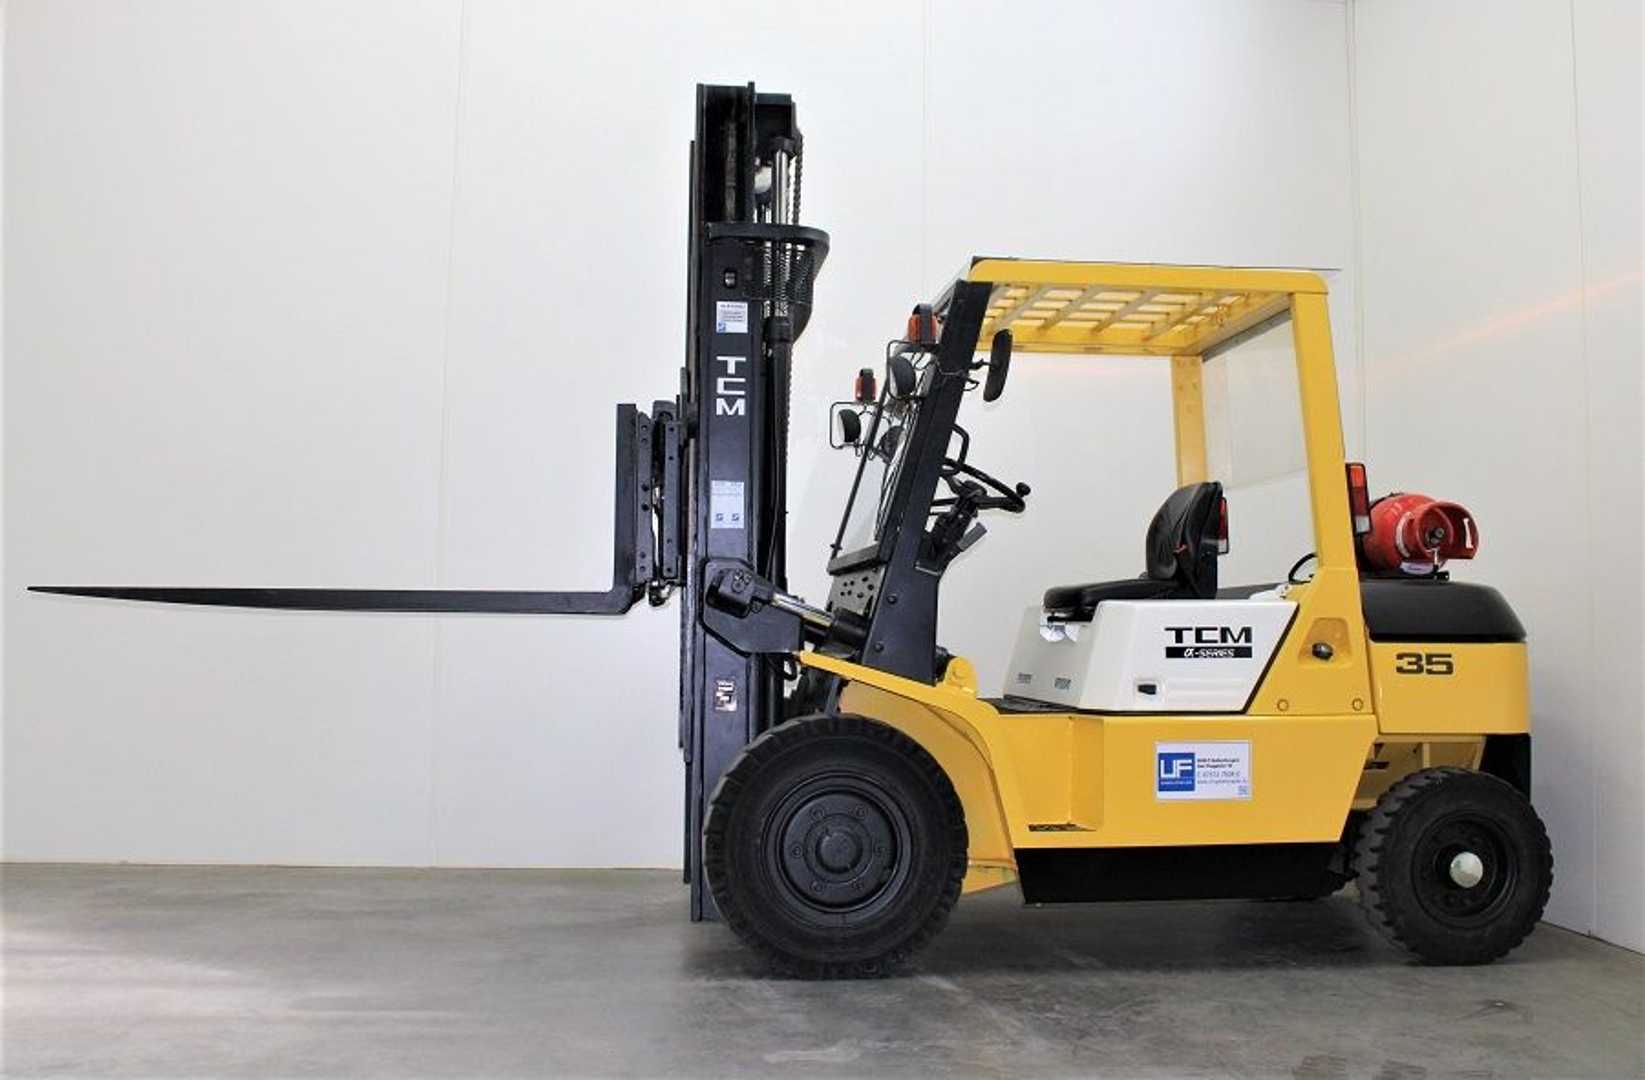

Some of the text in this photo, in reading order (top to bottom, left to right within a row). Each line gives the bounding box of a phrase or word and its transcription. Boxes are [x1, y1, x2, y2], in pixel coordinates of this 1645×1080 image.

[716, 356, 746, 416] TCM
[1164, 627, 1252, 644] TCM
[1396, 653, 1454, 675] 35
